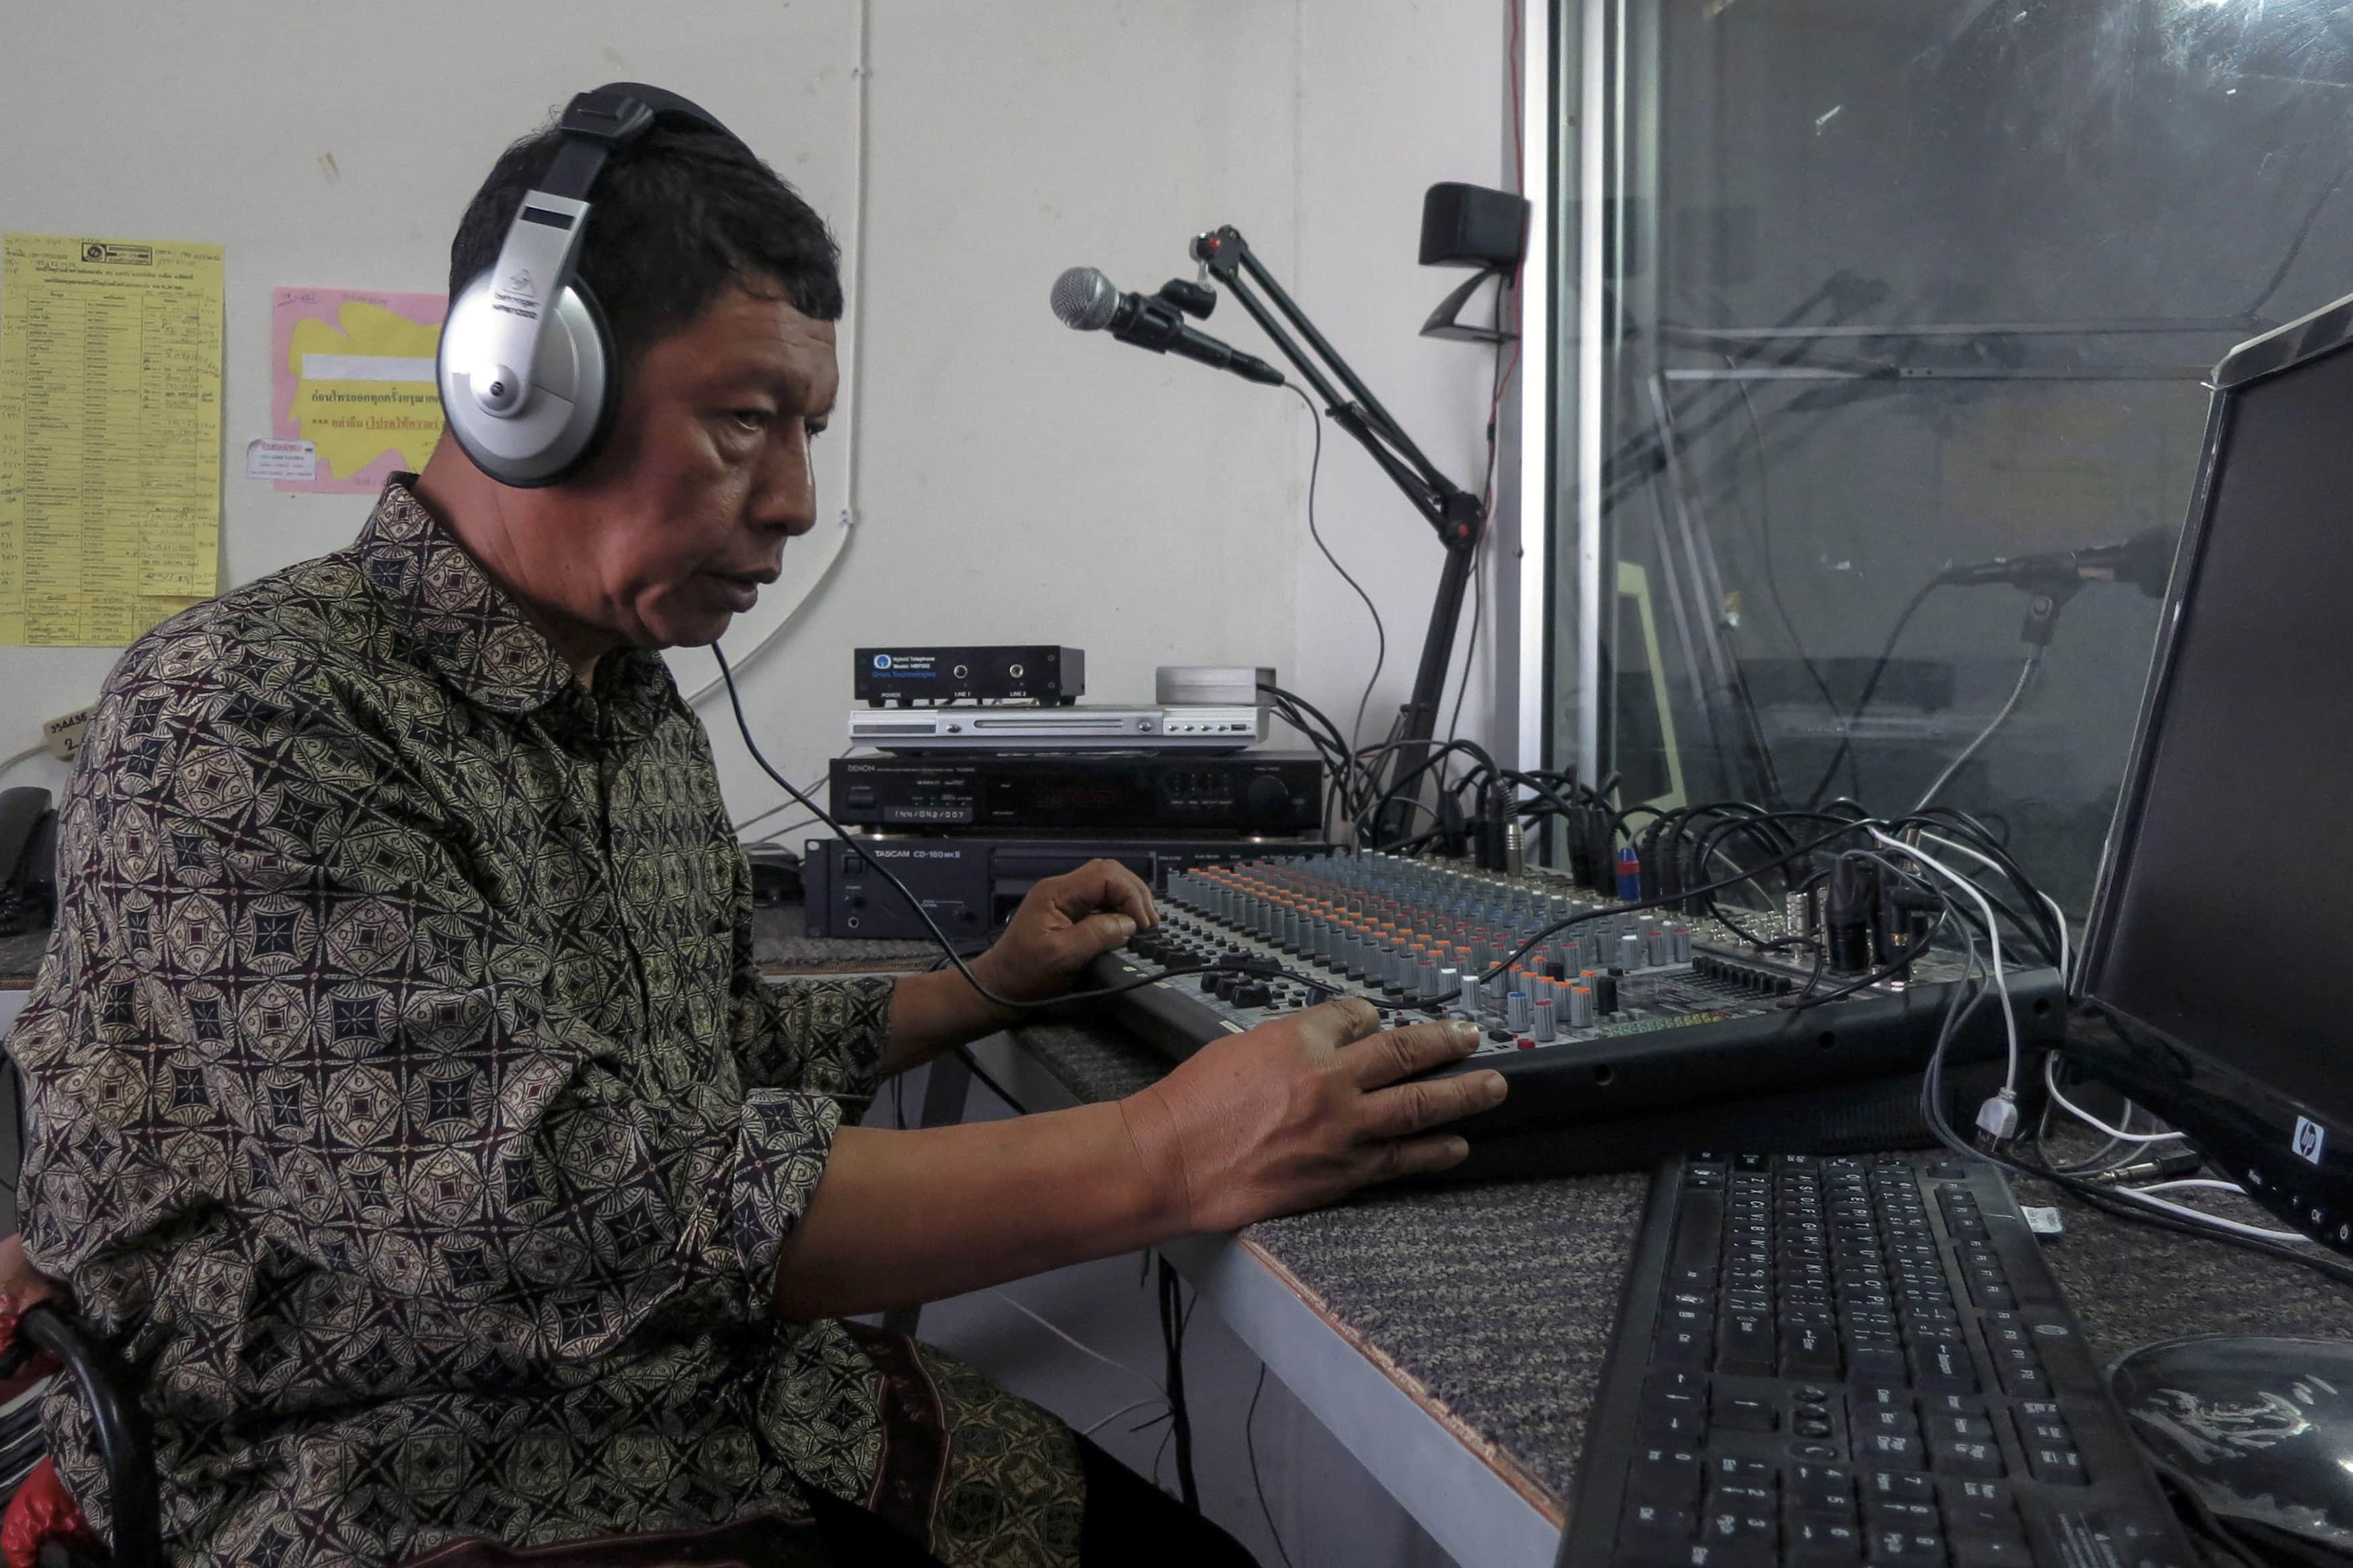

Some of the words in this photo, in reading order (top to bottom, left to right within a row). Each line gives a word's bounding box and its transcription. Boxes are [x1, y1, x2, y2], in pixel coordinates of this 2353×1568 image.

[65, 738, 79, 751] 2
[847, 764, 875, 772] DENON
[875, 850, 910, 858] TASCAM
